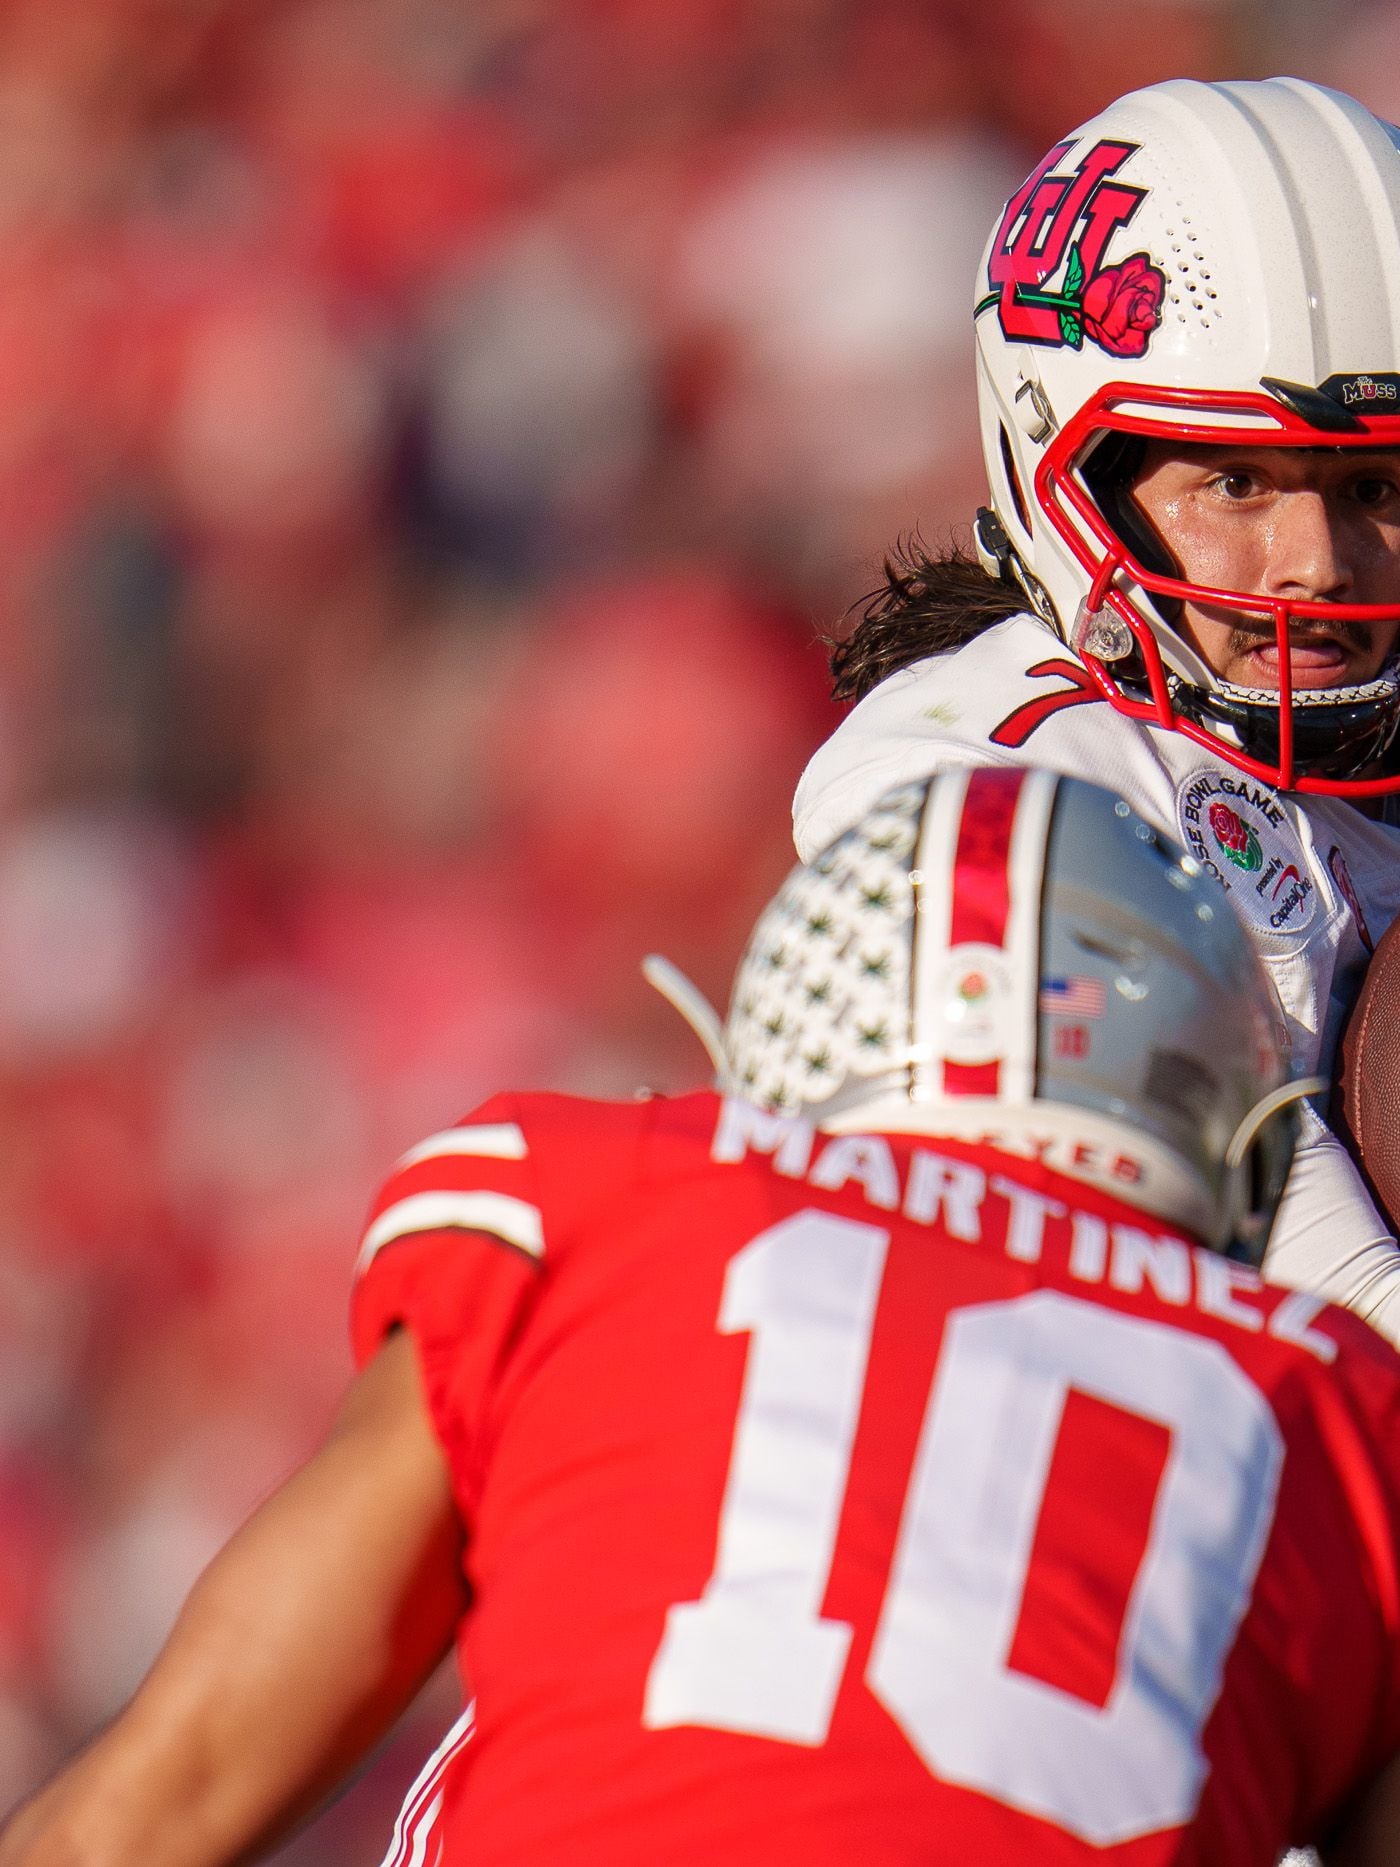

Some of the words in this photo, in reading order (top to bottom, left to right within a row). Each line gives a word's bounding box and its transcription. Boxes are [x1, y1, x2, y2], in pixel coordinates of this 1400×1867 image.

[1342, 381, 1397, 404] MUSS
[1185, 778, 1222, 825] BOWL
[1219, 777, 1285, 829] GAME
[641, 1207, 1287, 1849] 10
